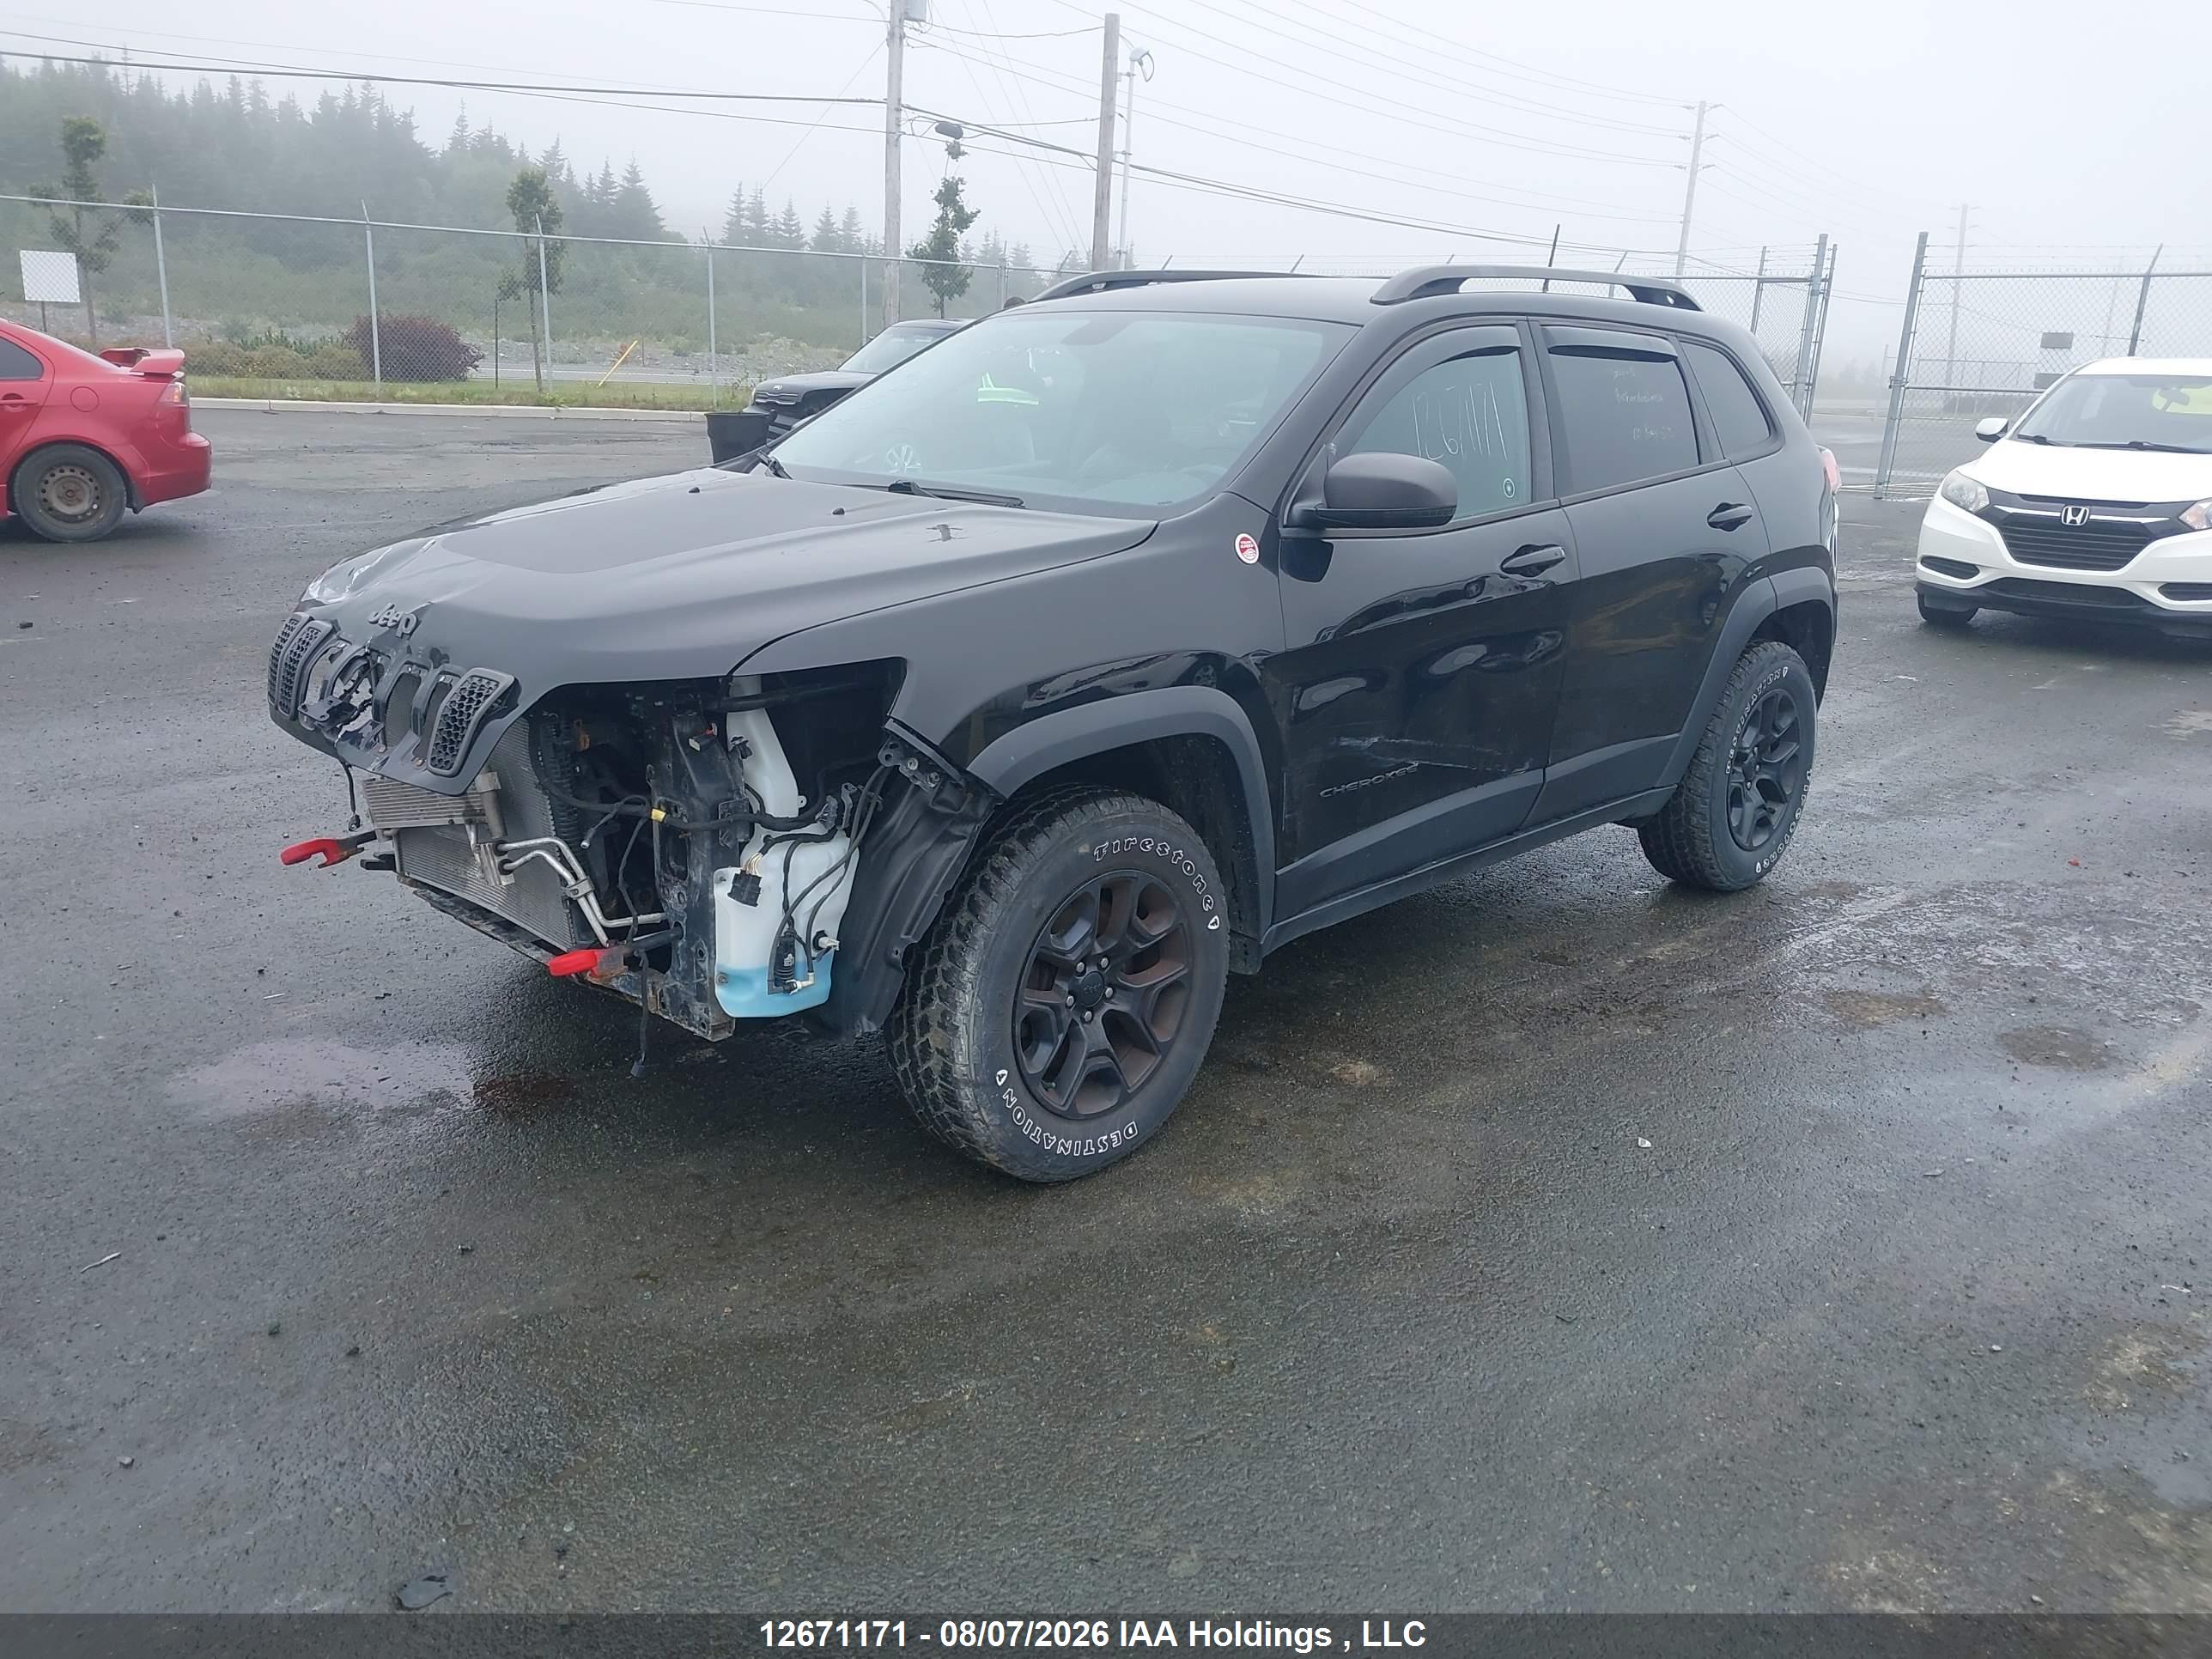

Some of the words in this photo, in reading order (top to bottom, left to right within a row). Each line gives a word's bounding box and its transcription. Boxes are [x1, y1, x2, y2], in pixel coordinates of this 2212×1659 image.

[367, 603, 417, 638] Jeep
[1319, 761, 1419, 798] CHEROKEE
[1093, 837, 1214, 912] Firestone
[1002, 1088, 1139, 1157] DESTINATION
